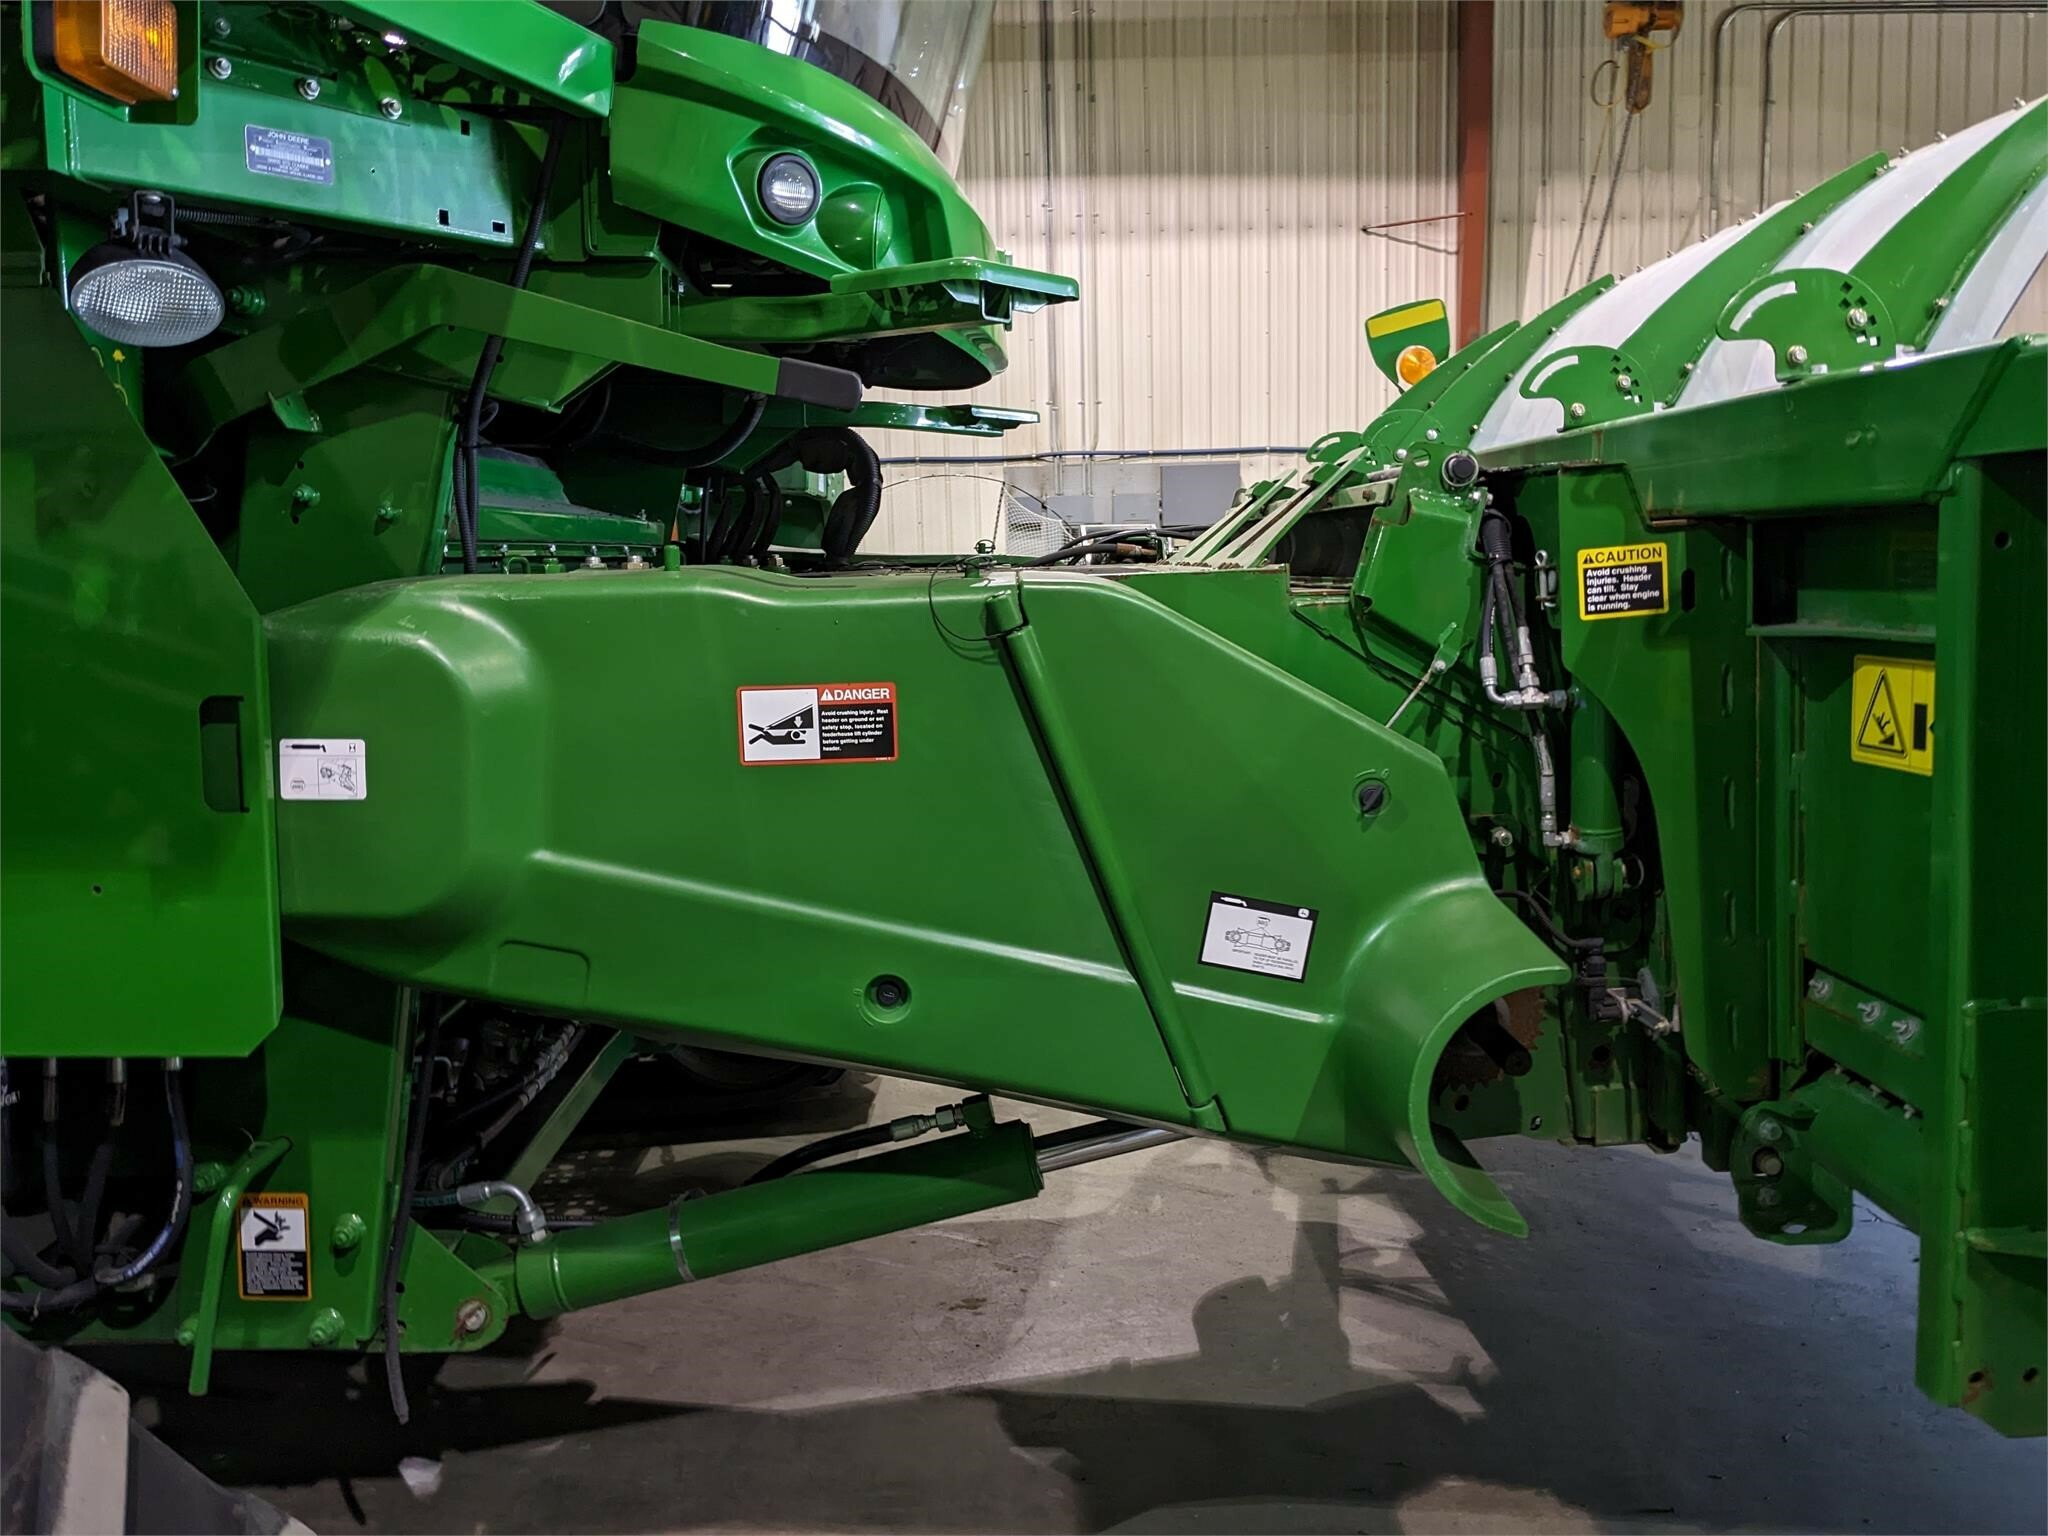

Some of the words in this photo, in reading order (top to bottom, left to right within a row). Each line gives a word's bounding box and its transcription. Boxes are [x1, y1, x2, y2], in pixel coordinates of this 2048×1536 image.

[268, 131, 286, 140] JOHN
[288, 135, 310, 144] DEERE
[1595, 547, 1662, 563] CAUTION
[1586, 568, 1610, 577] Avoid
[1612, 566, 1648, 575] crushing
[1586, 576, 1619, 587] injuries.
[1623, 574, 1652, 582] Header
[1587, 586, 1602, 595] can
[1604, 584, 1616, 593] tilt.
[1620, 583, 1639, 592] Stay
[1587, 594, 1607, 603] clear
[1608, 592, 1631, 601] when
[1632, 590, 1660, 600] engine
[1588, 603, 1596, 612] is
[1596, 601, 1630, 610] running.
[834, 688, 890, 701] DANGER
[849, 716, 868, 724] ground
[254, 1196, 304, 1206] WARNING
